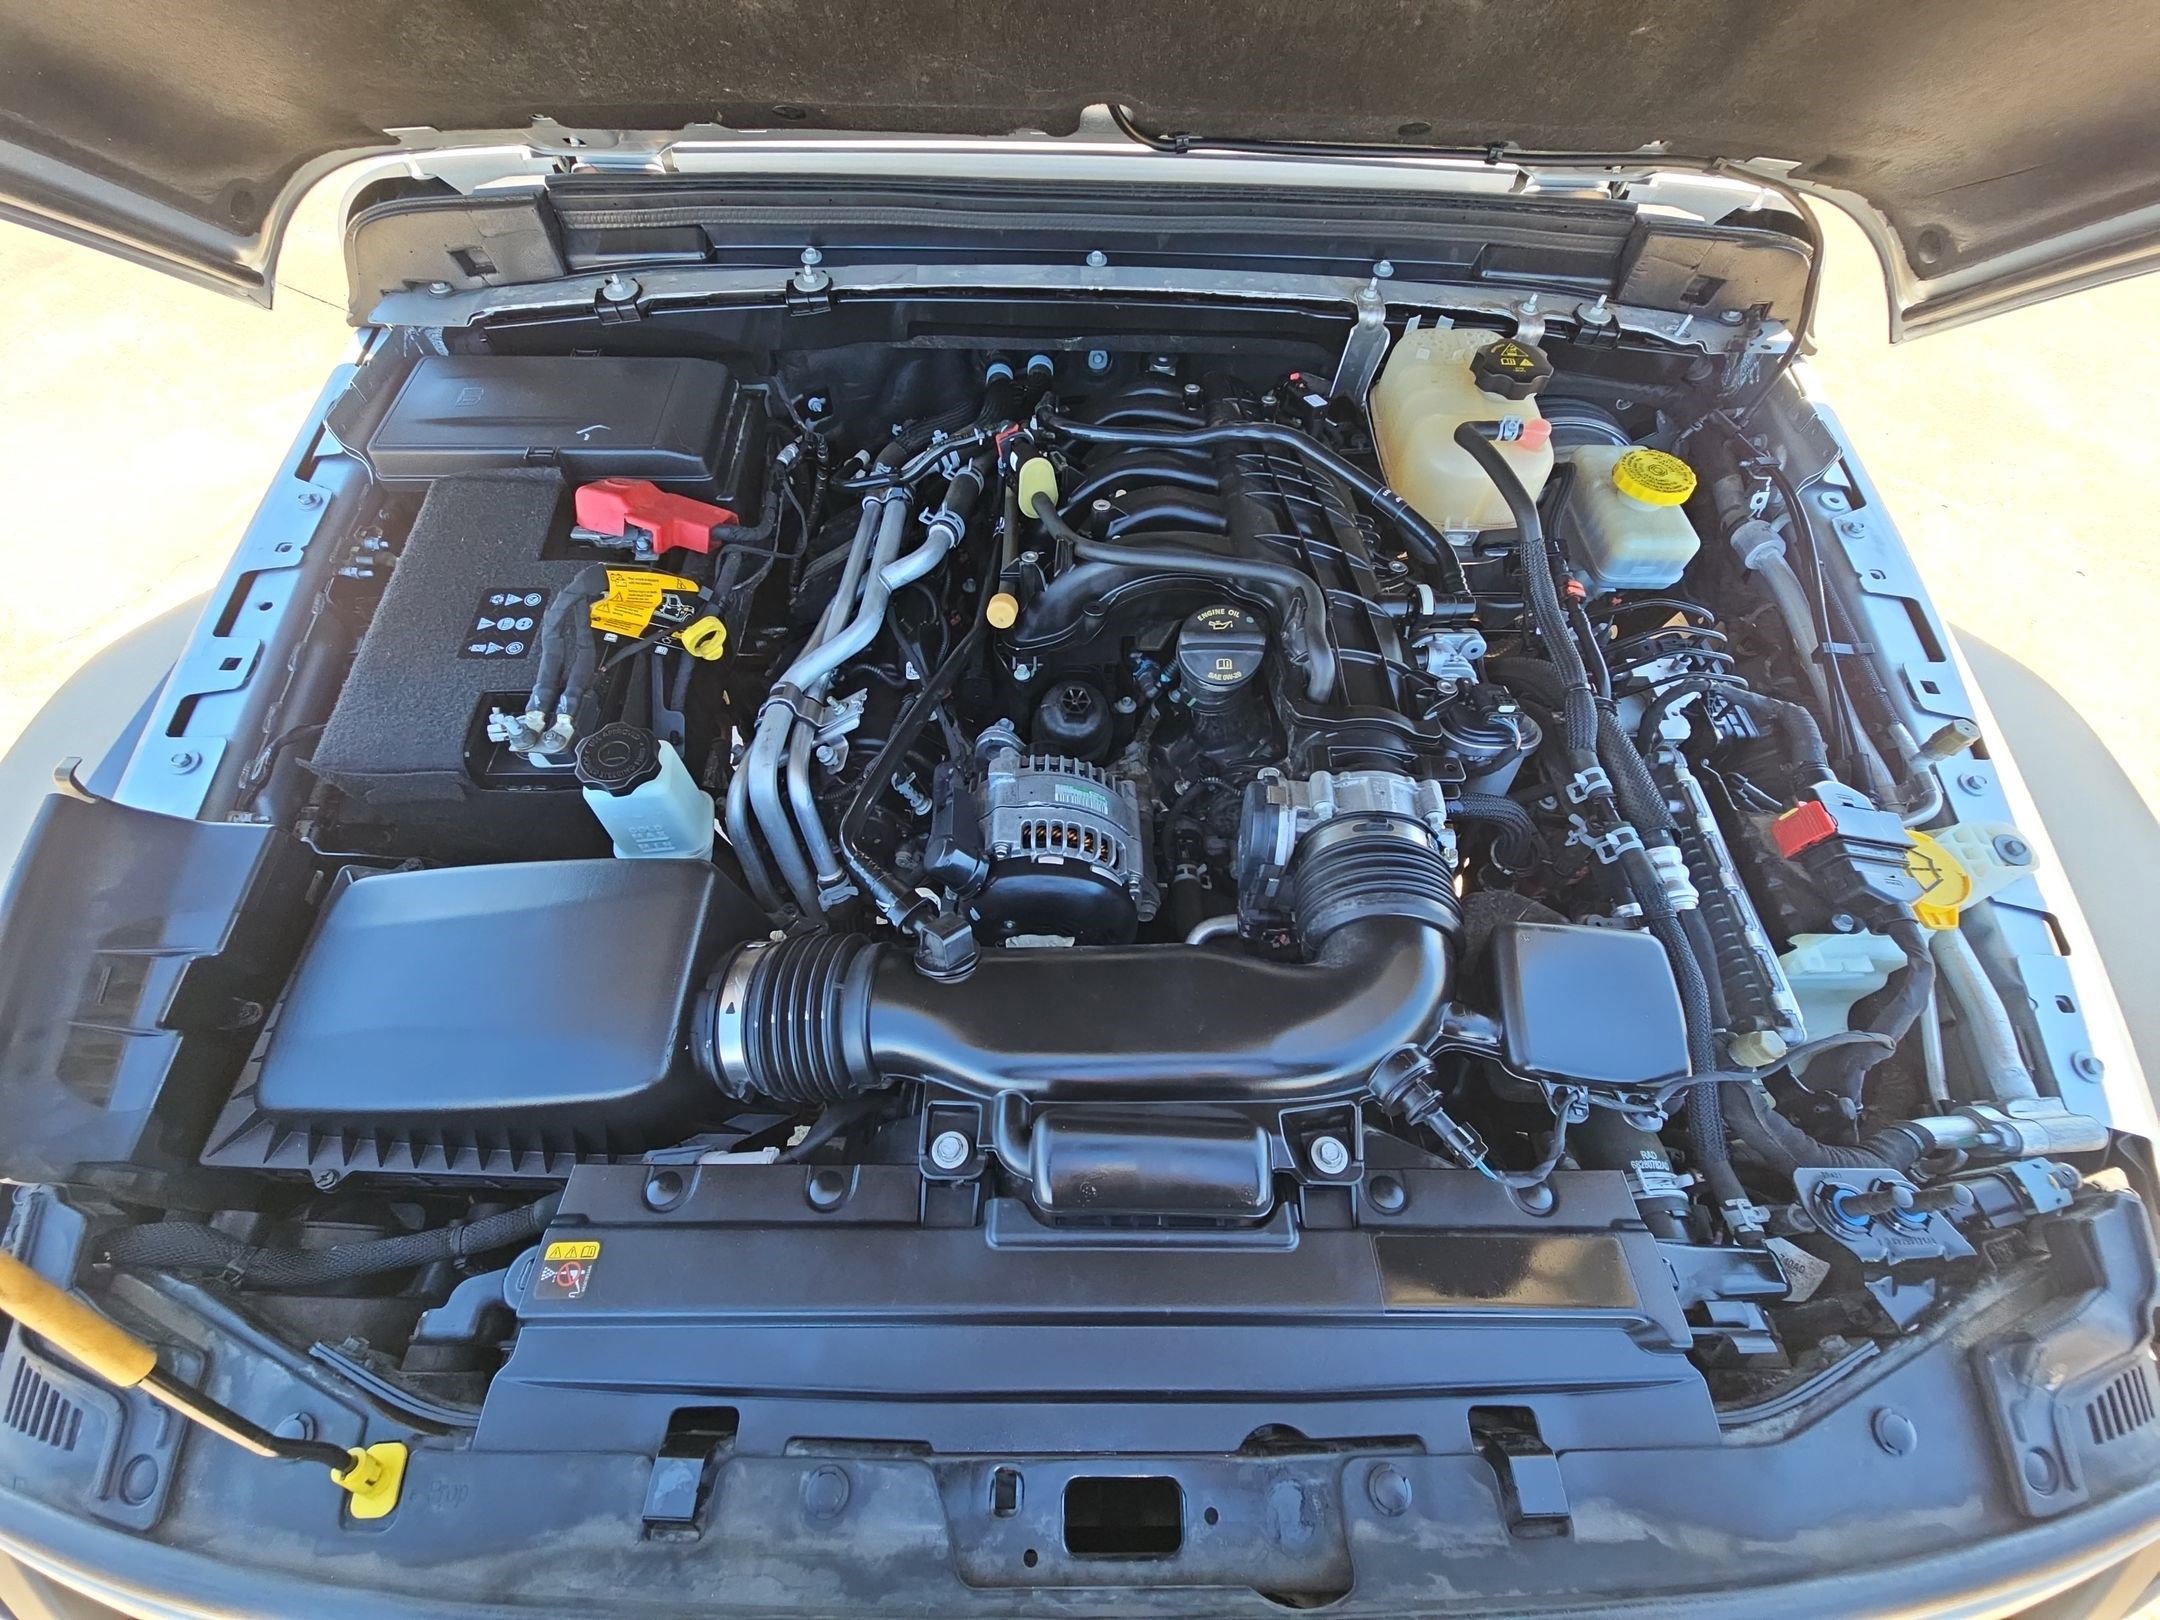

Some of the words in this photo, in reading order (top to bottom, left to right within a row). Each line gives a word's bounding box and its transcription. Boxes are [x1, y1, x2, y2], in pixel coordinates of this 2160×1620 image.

[1197, 608, 1225, 621] ENGINE
[1228, 609, 1240, 618] OIL
[1639, 1150, 1658, 1160] RAD
